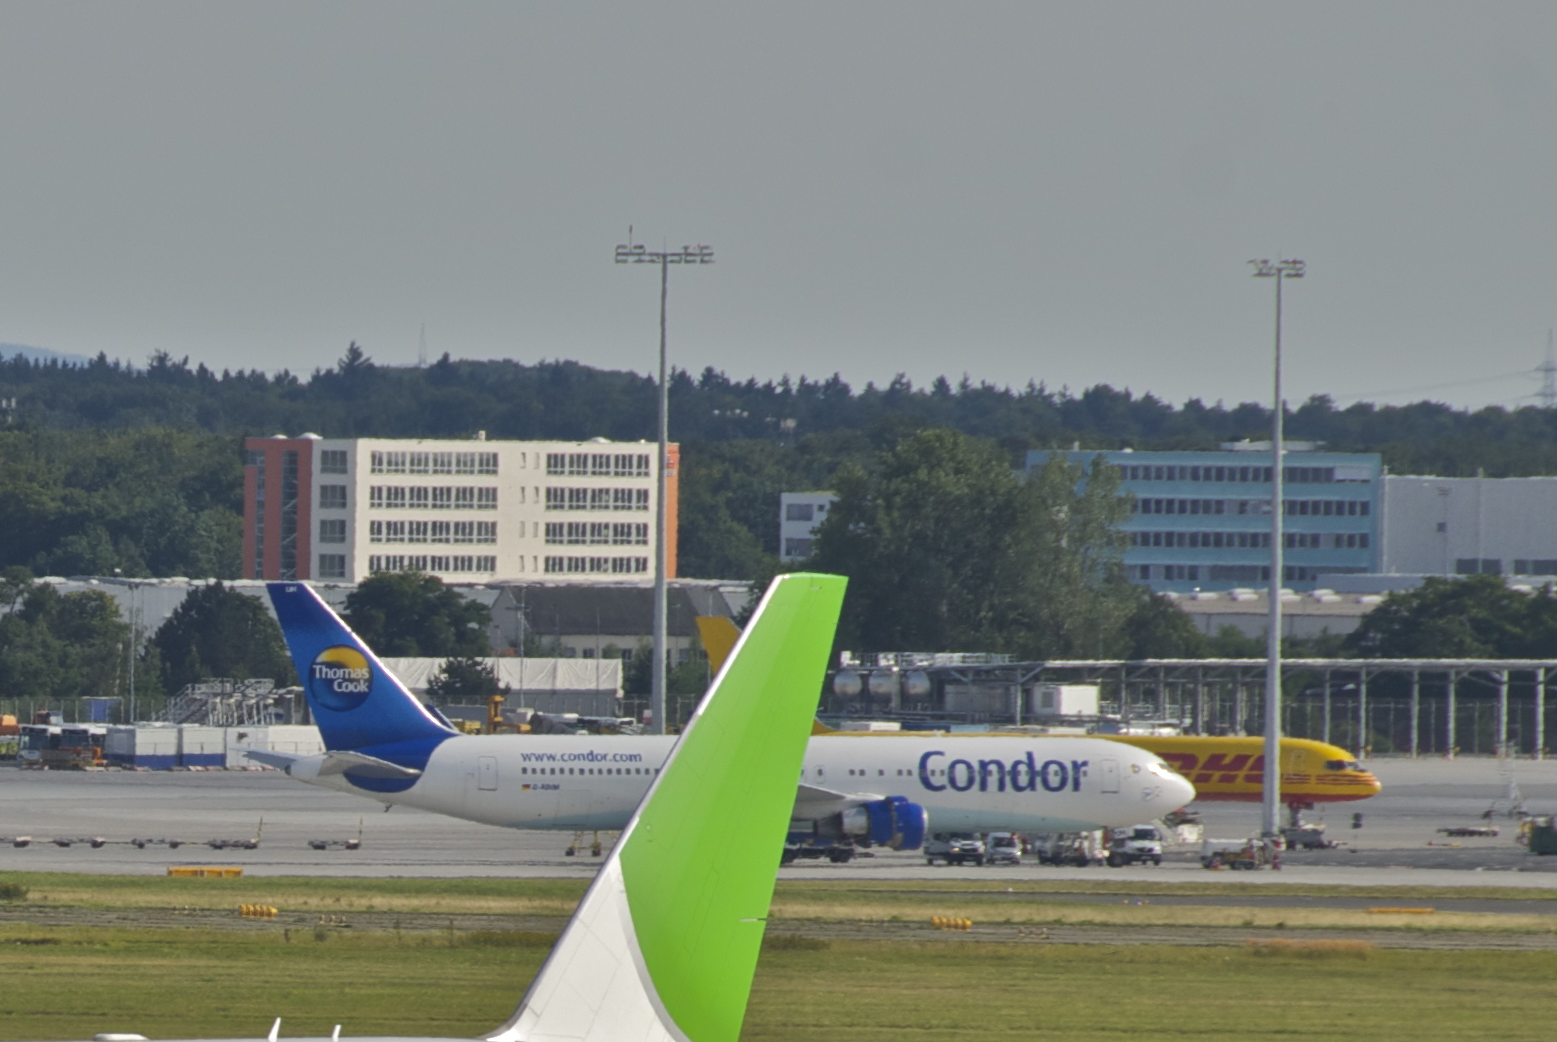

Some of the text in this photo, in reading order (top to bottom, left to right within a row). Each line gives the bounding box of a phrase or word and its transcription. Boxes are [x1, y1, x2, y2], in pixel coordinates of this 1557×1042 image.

[312, 664, 369, 679] Thomas
[333, 679, 369, 692] Cook
[520, 750, 643, 762] www.condor.com
[918, 750, 1089, 793] Condor
